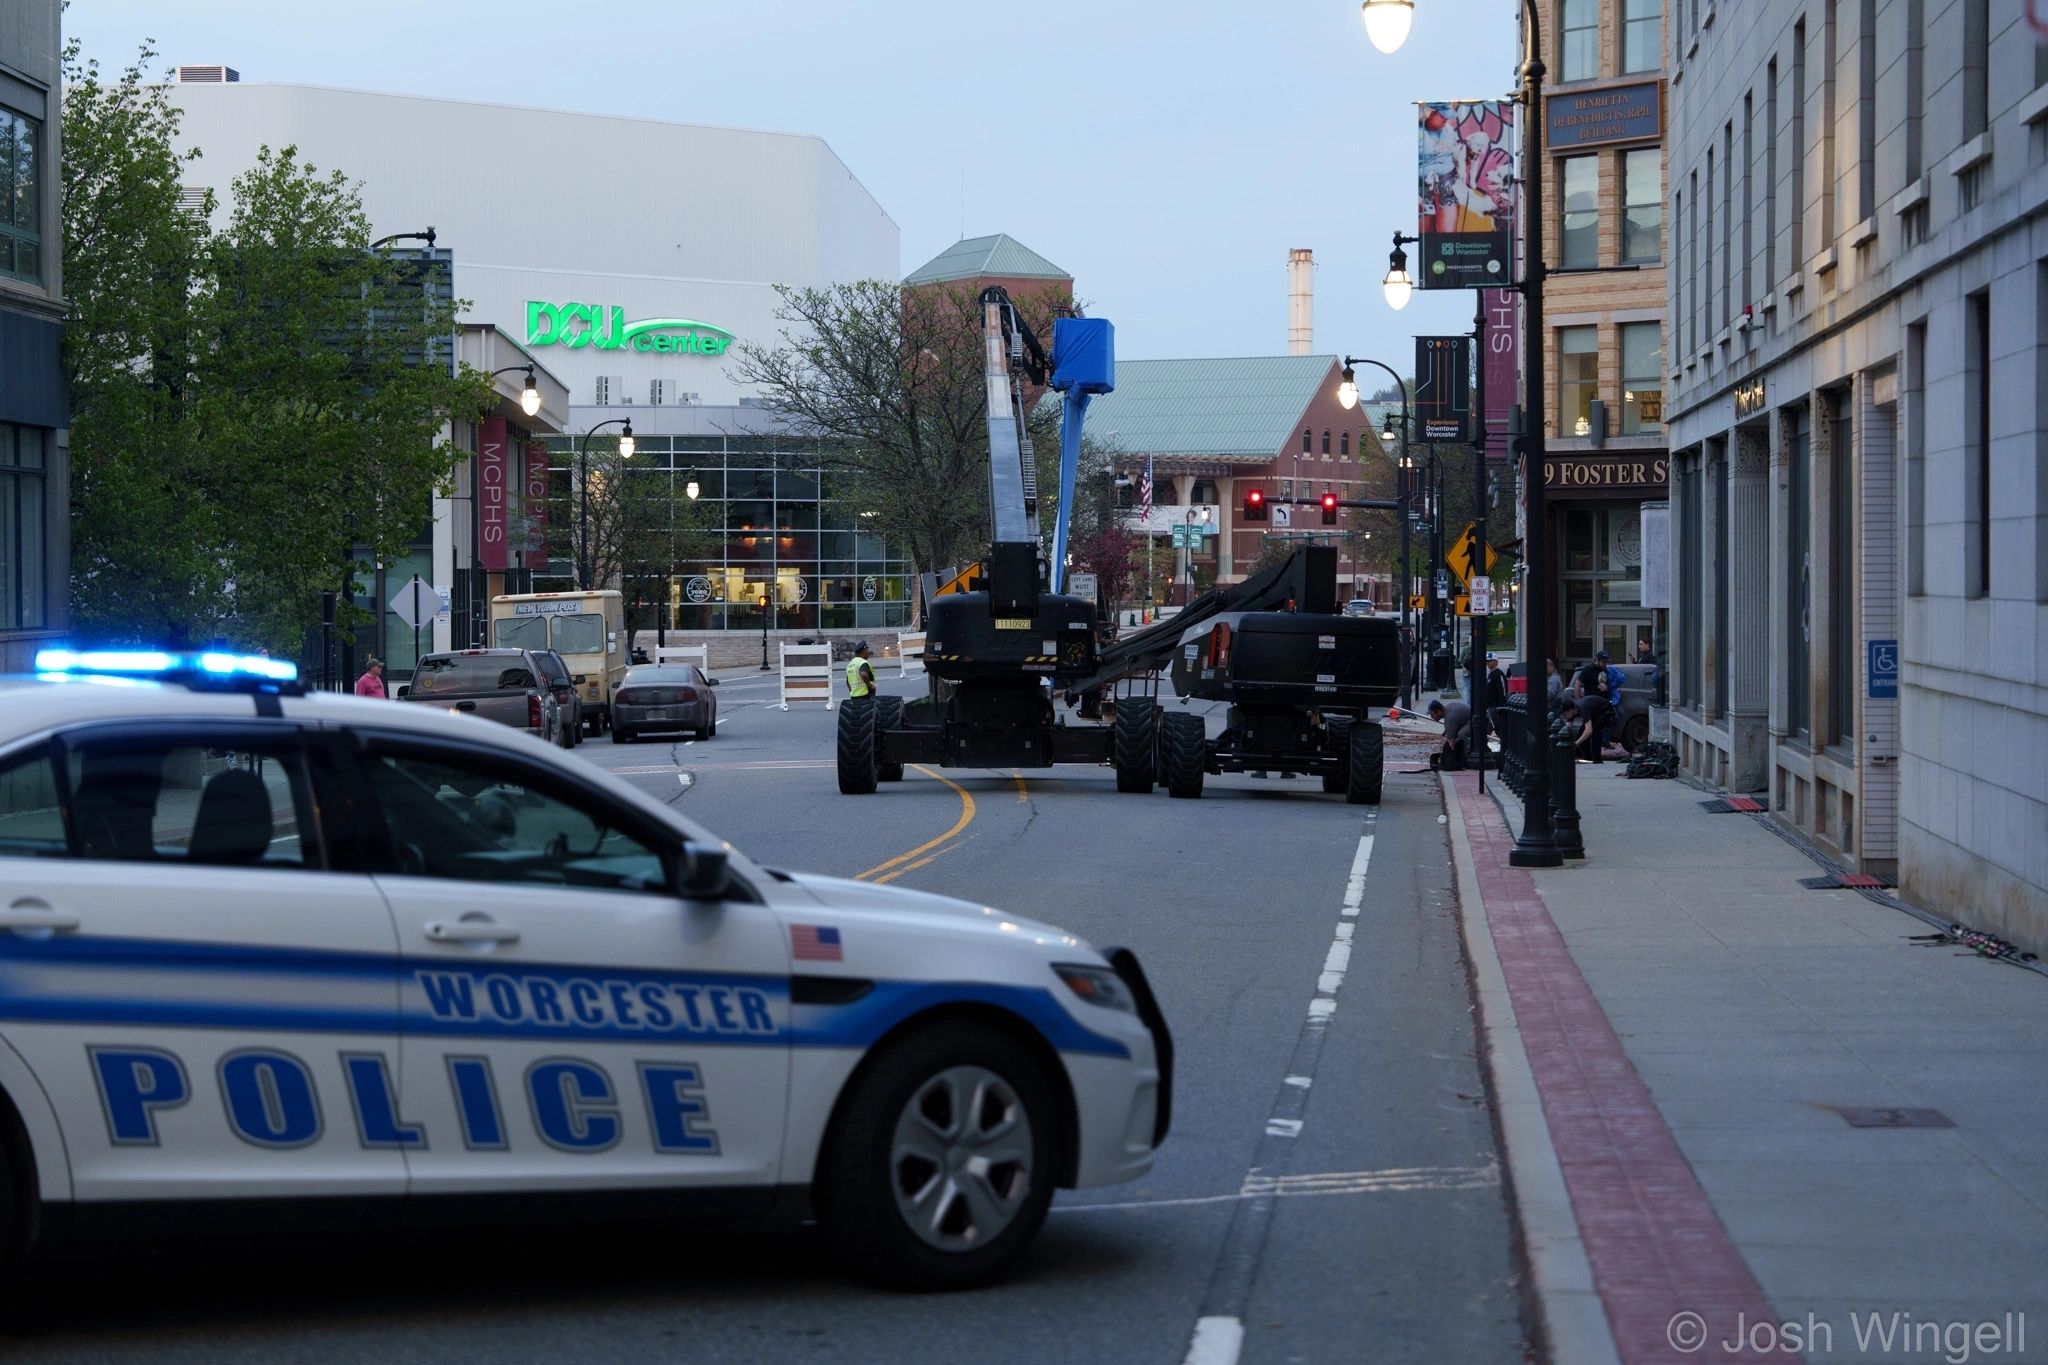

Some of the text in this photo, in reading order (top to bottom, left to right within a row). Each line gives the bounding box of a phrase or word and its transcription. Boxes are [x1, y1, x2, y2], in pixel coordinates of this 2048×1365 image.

[1575, 96, 1629, 109] HENRIETTA
[1580, 125, 1625, 138] BUILDING
[524, 301, 732, 356] DCU center
[1560, 463, 1646, 485] FOSTER
[1653, 460, 1670, 483] S
[484, 443, 502, 543] MCPHS
[516, 603, 535, 614] NEW
[559, 602, 580, 612] POST
[415, 970, 779, 1037] WORCESTER
[85, 1045, 722, 1156] POLICE
